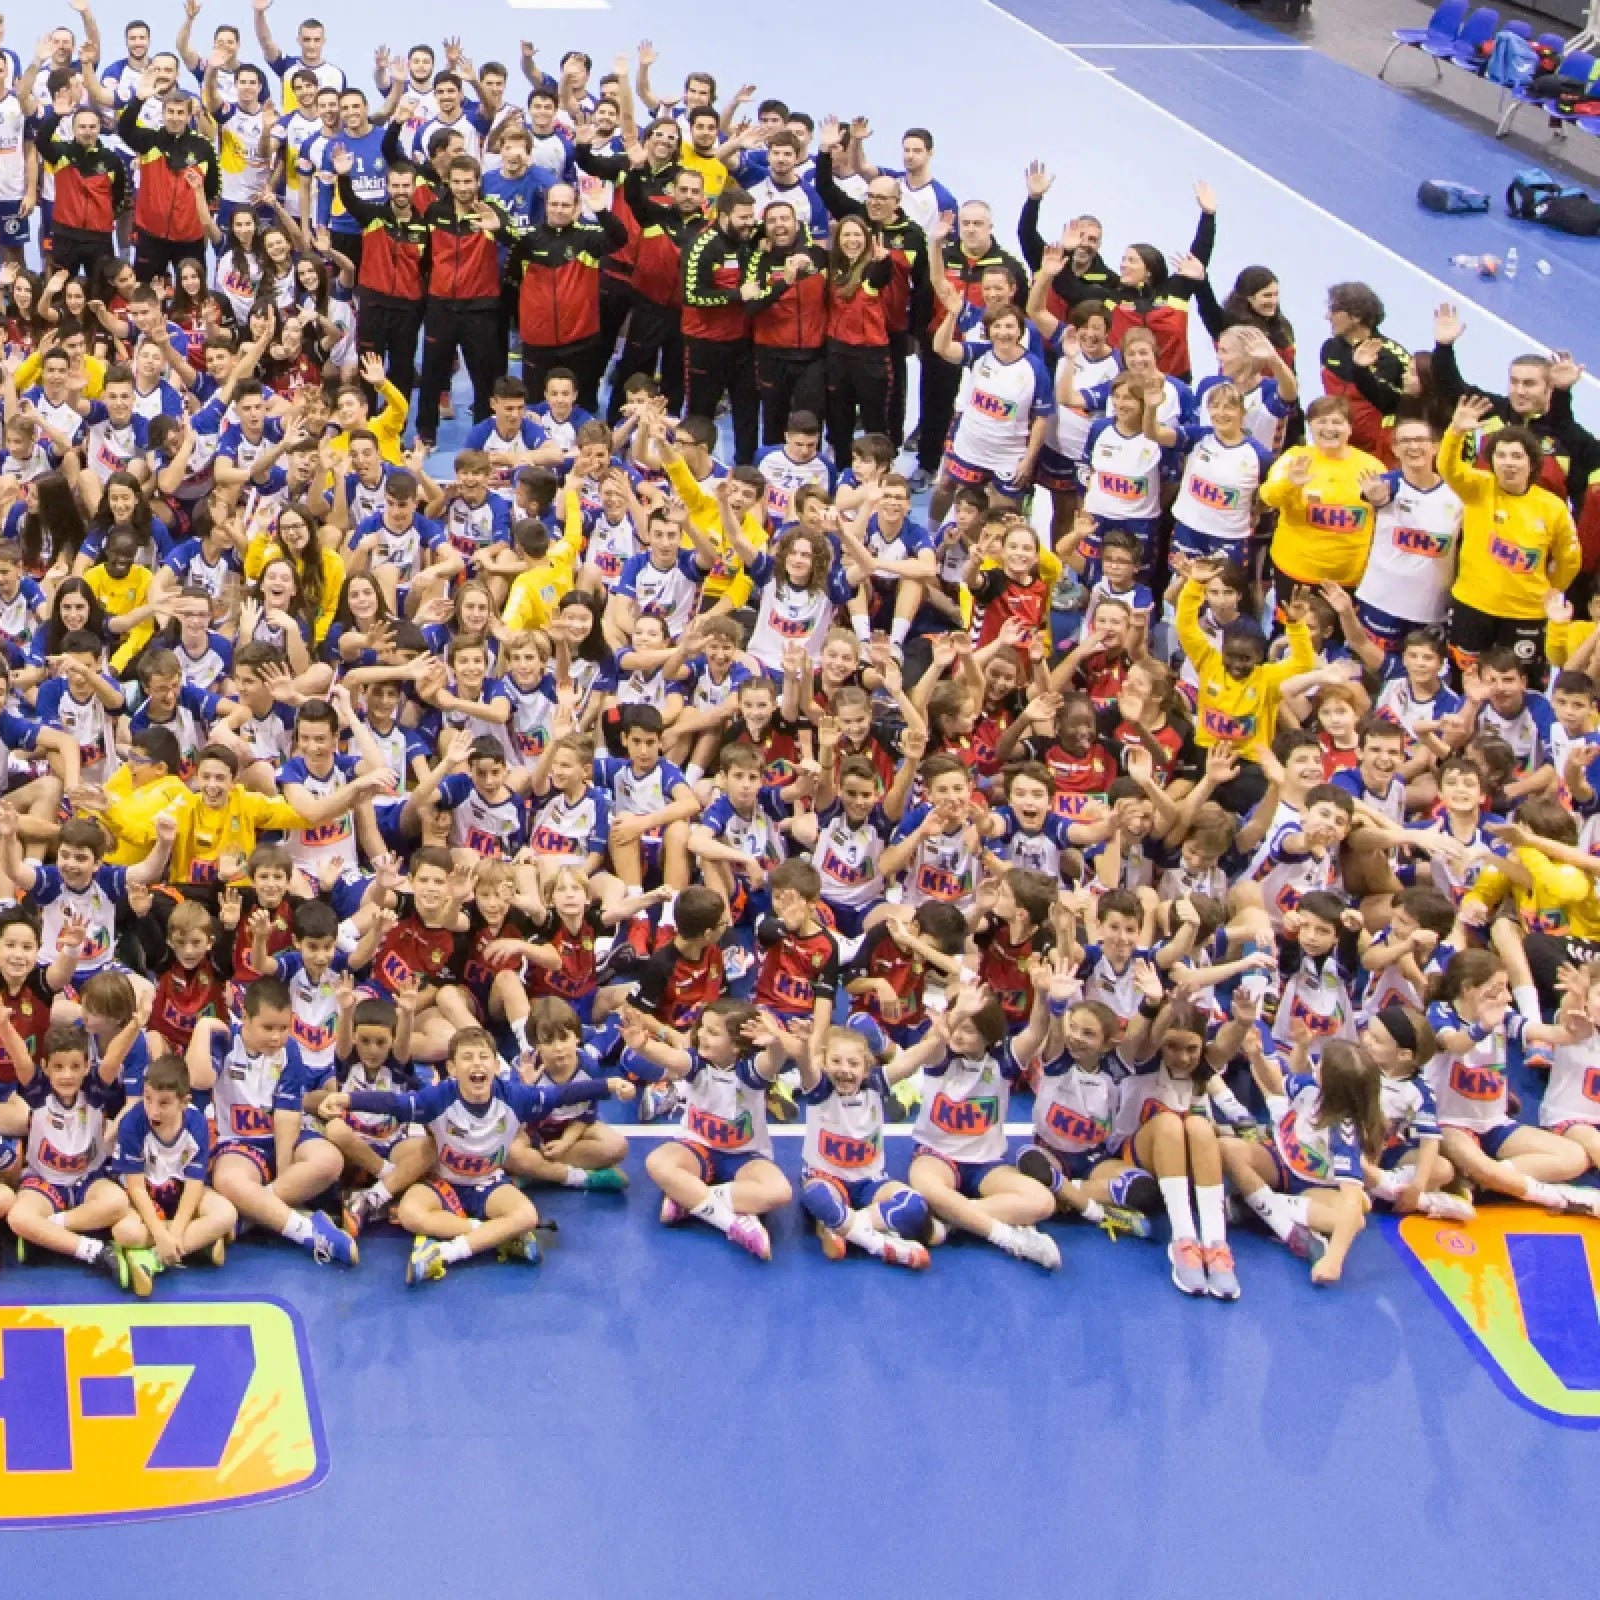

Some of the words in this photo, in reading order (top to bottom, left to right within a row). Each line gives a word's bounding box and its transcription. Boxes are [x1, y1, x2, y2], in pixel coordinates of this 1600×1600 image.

[974, 393, 1016, 417] KH-7
[1102, 476, 1147, 497] KH-7
[1191, 478, 1238, 505] KH-7
[1311, 506, 1364, 528] KH-7
[1397, 531, 1449, 554] KH-7
[1491, 535, 1540, 570] KH-7
[595, 555, 623, 573] KH-
[1205, 711, 1255, 734] KH-7
[303, 816, 349, 841] KH-7
[294, 1018, 336, 1048] KH-7
[690, 1110, 751, 1143] KH-7
[933, 1101, 994, 1131] KH-7
